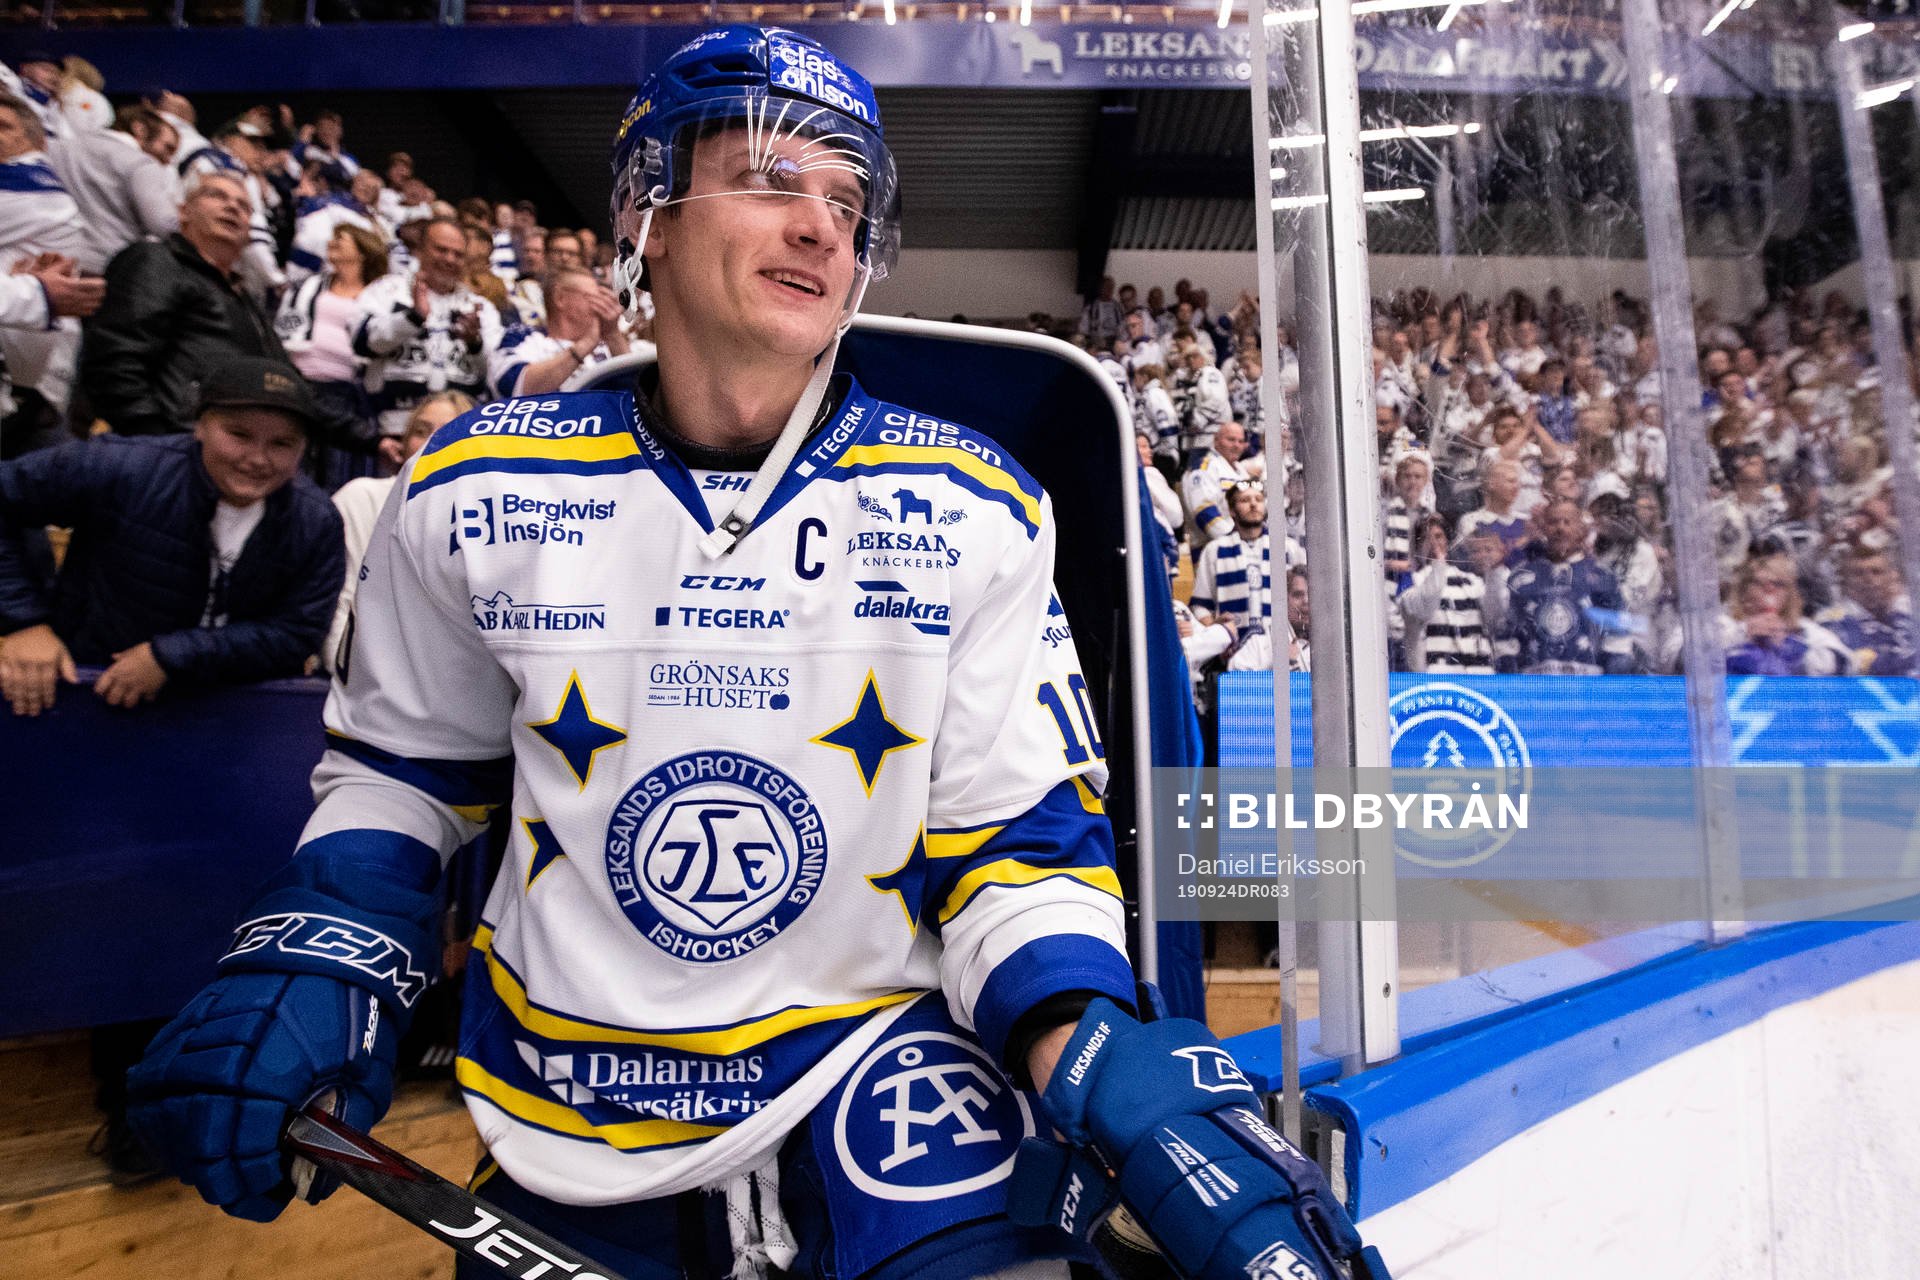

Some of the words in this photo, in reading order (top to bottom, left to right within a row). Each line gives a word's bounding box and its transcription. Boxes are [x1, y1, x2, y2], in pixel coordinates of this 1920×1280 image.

[780, 46, 838, 81] clas
[781, 67, 869, 120] ohlson
[469, 414, 601, 436] ohlson
[481, 399, 560, 416] clas
[884, 413, 960, 435] clas
[811, 404, 866, 461] TEGERA
[879, 428, 1002, 467] ohlson
[503, 493, 616, 521] Bergkvist
[503, 521, 584, 546] Insjön
[795, 517, 828, 581] C
[862, 555, 949, 569] KNÄCKEBR
[680, 575, 766, 591] CCM
[854, 596, 951, 621] dalakra
[650, 660, 790, 687] GRÖNSAKS
[682, 687, 771, 710] HUSET
[607, 775, 668, 908] LEKSANDS
[648, 915, 781, 961] ISHOCKEY
[587, 1053, 763, 1088] Dalarnas
[1067, 1027, 1107, 1087] LEKSANDS
[1060, 1172, 1085, 1235] CCM
[429, 1206, 612, 1280] JET
